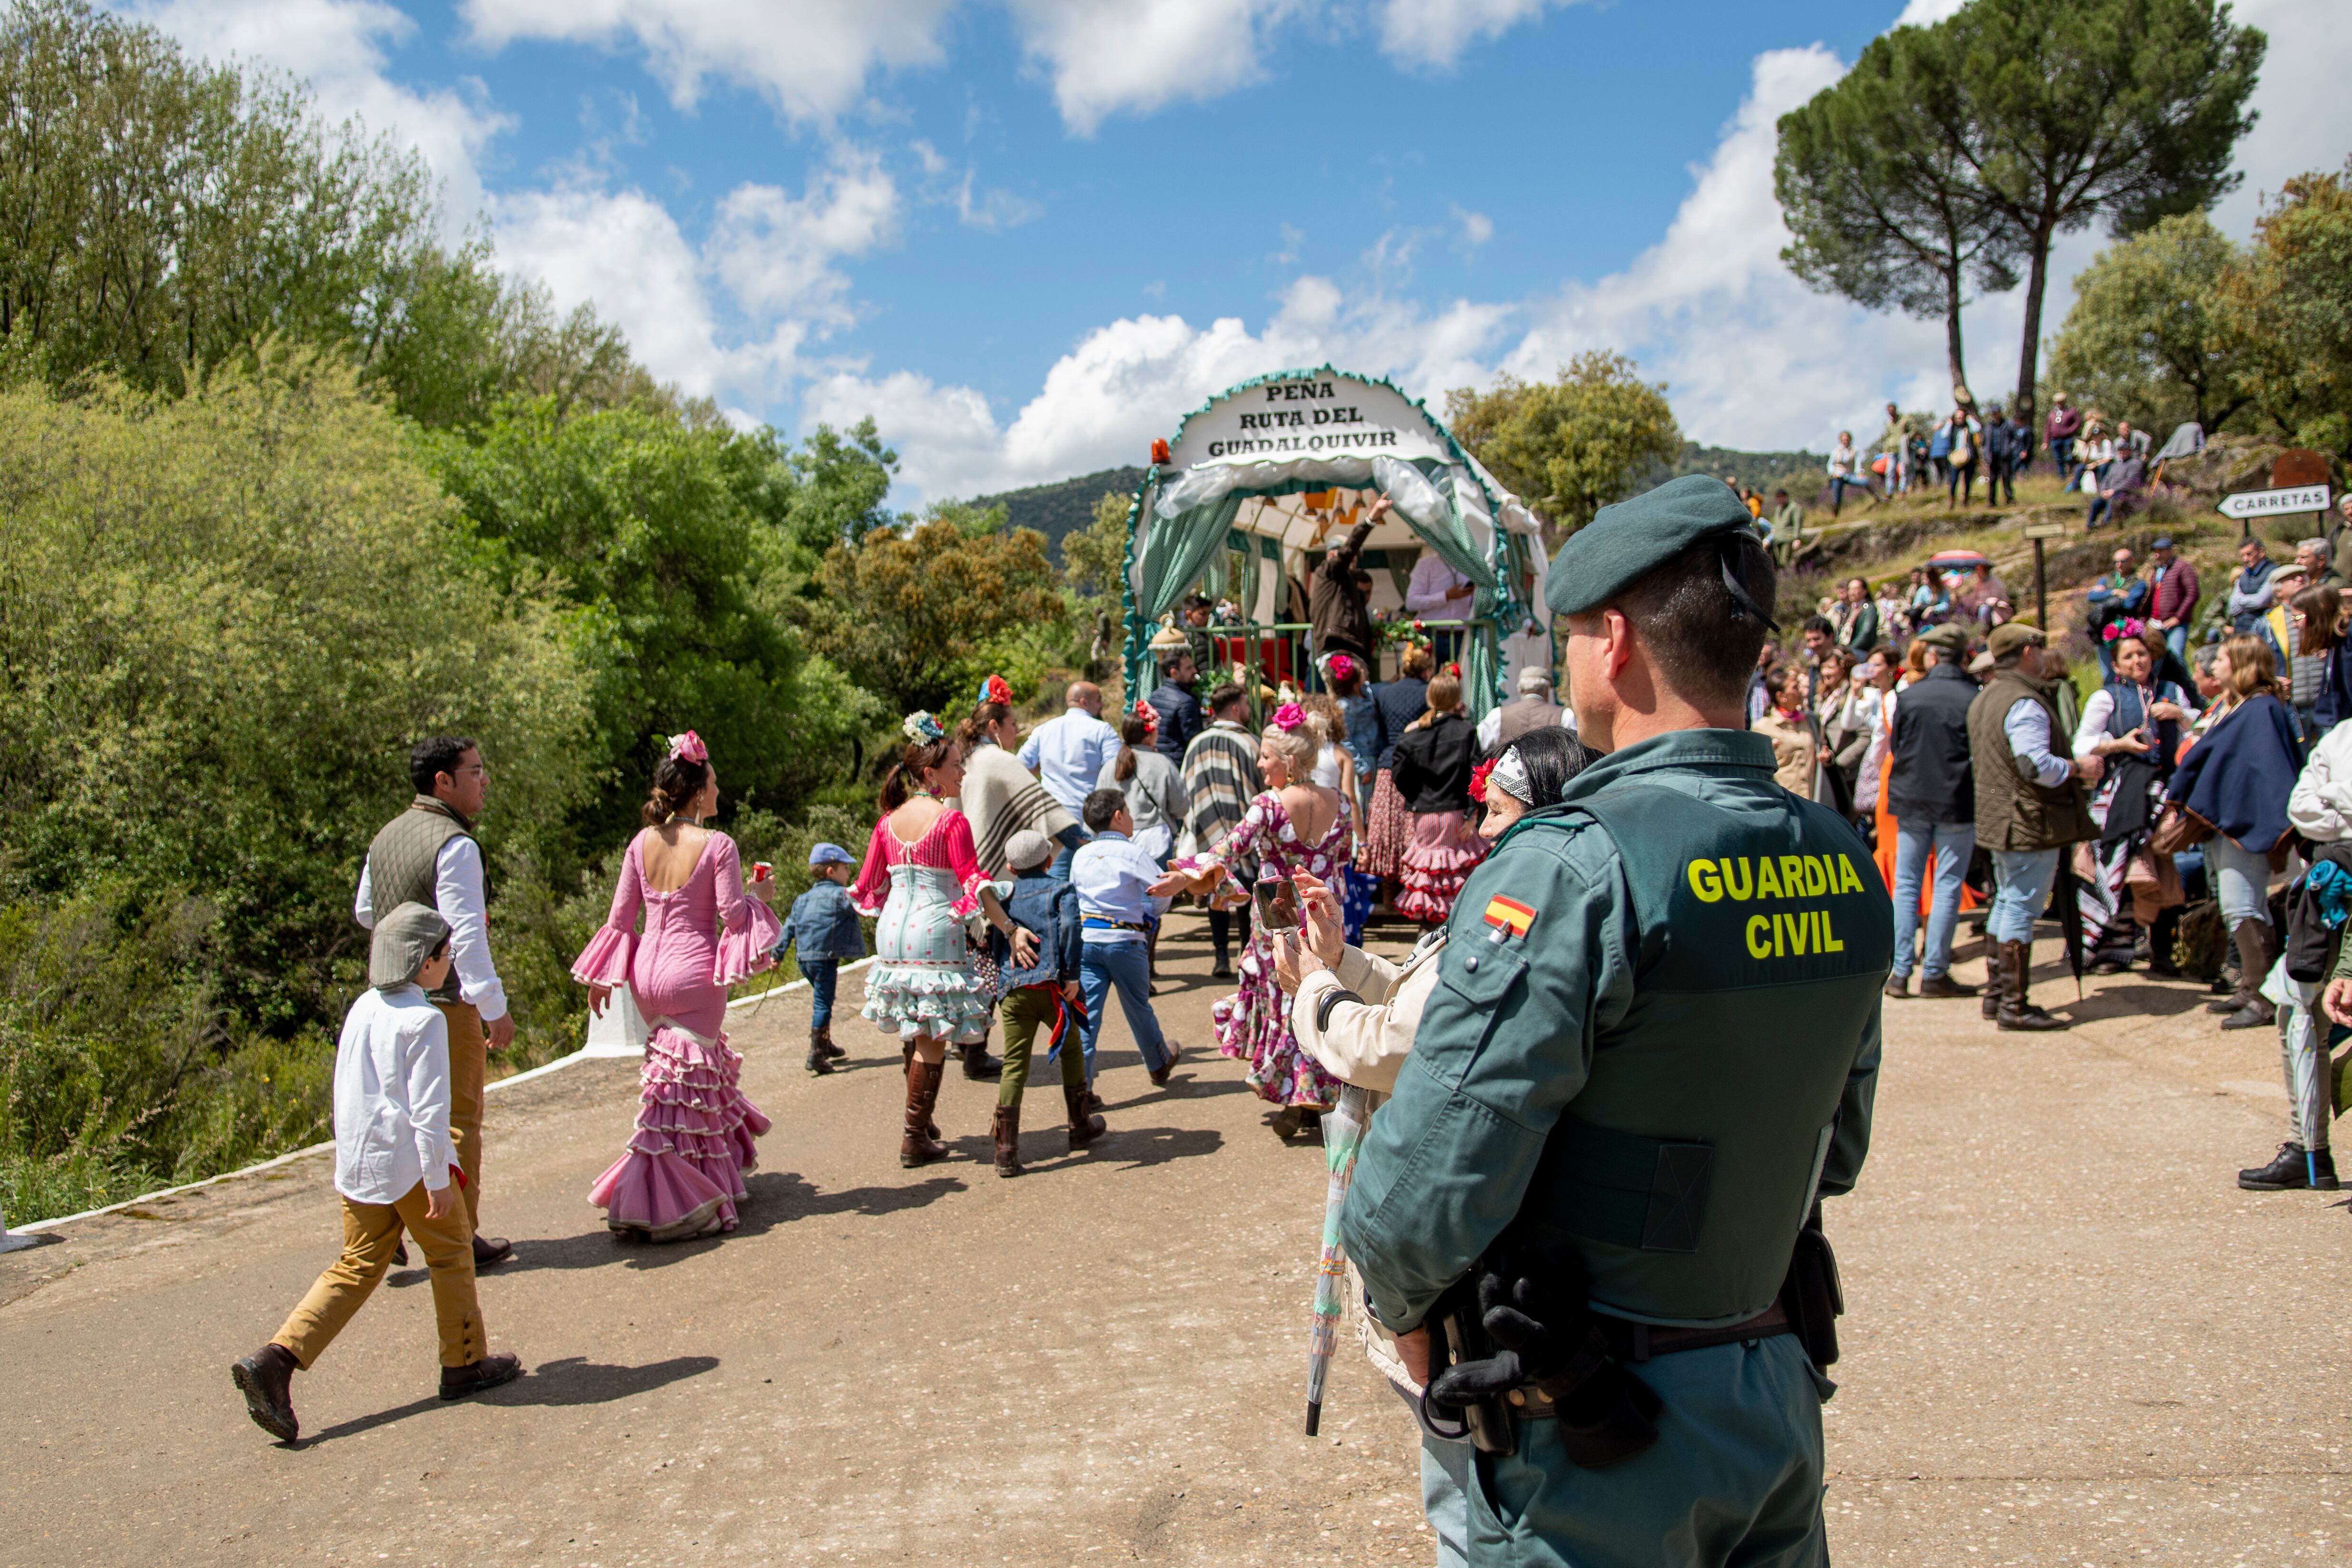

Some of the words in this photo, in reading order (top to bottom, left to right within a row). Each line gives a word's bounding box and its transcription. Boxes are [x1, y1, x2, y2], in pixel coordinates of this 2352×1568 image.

[1265, 378, 1335, 402] PEÑA
[1240, 410, 1304, 429] RUTA
[1313, 406, 1364, 424] DEL
[1208, 430, 1397, 457] GUADALQUIVIR
[2235, 492, 2323, 511] CARRETAS
[1688, 854, 1864, 902] GUARDIA
[1746, 910, 1843, 959] CIVIL
